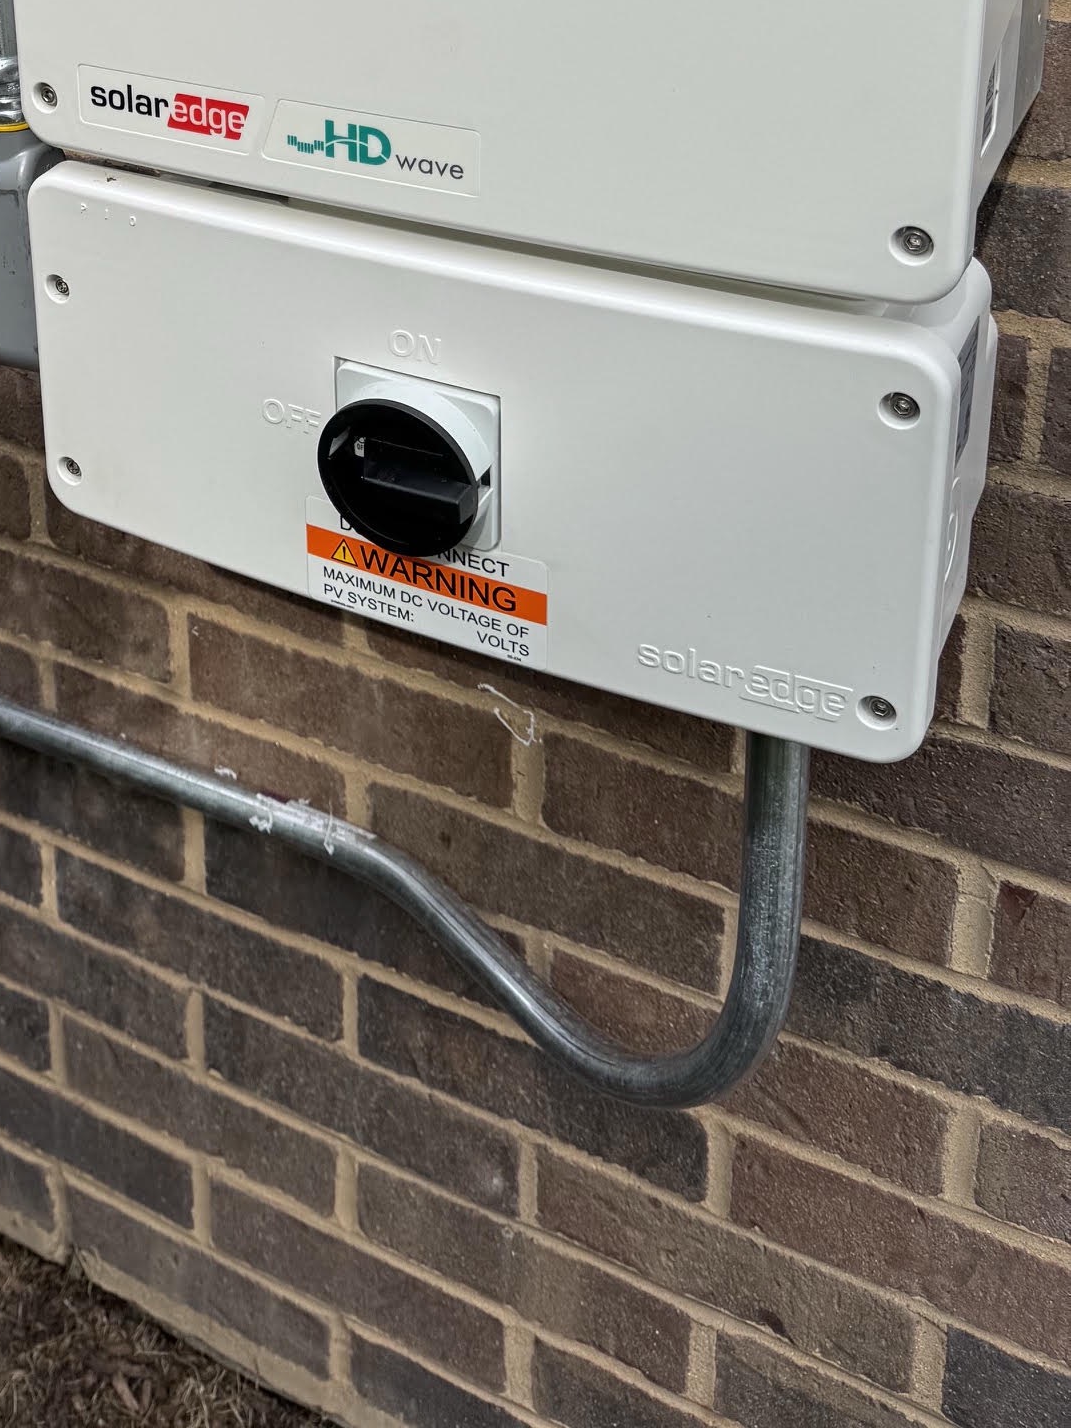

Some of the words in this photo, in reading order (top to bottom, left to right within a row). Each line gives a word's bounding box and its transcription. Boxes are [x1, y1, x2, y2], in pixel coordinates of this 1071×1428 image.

[90, 84, 250, 140] solaredge
[395, 154, 465, 180] wave
[387, 329, 442, 365] ON
[261, 397, 322, 434] OFF
[360, 544, 517, 612] WARNING
[323, 566, 395, 599] MAXIMUM
[400, 590, 422, 607] DC
[427, 599, 502, 632] VOLTAGE
[507, 623, 529, 638] OF
[324, 584, 343, 599] PV
[348, 591, 414, 622] SYSTEM:
[477, 630, 529, 657] VOLTS
[638, 643, 854, 722] solaredge
